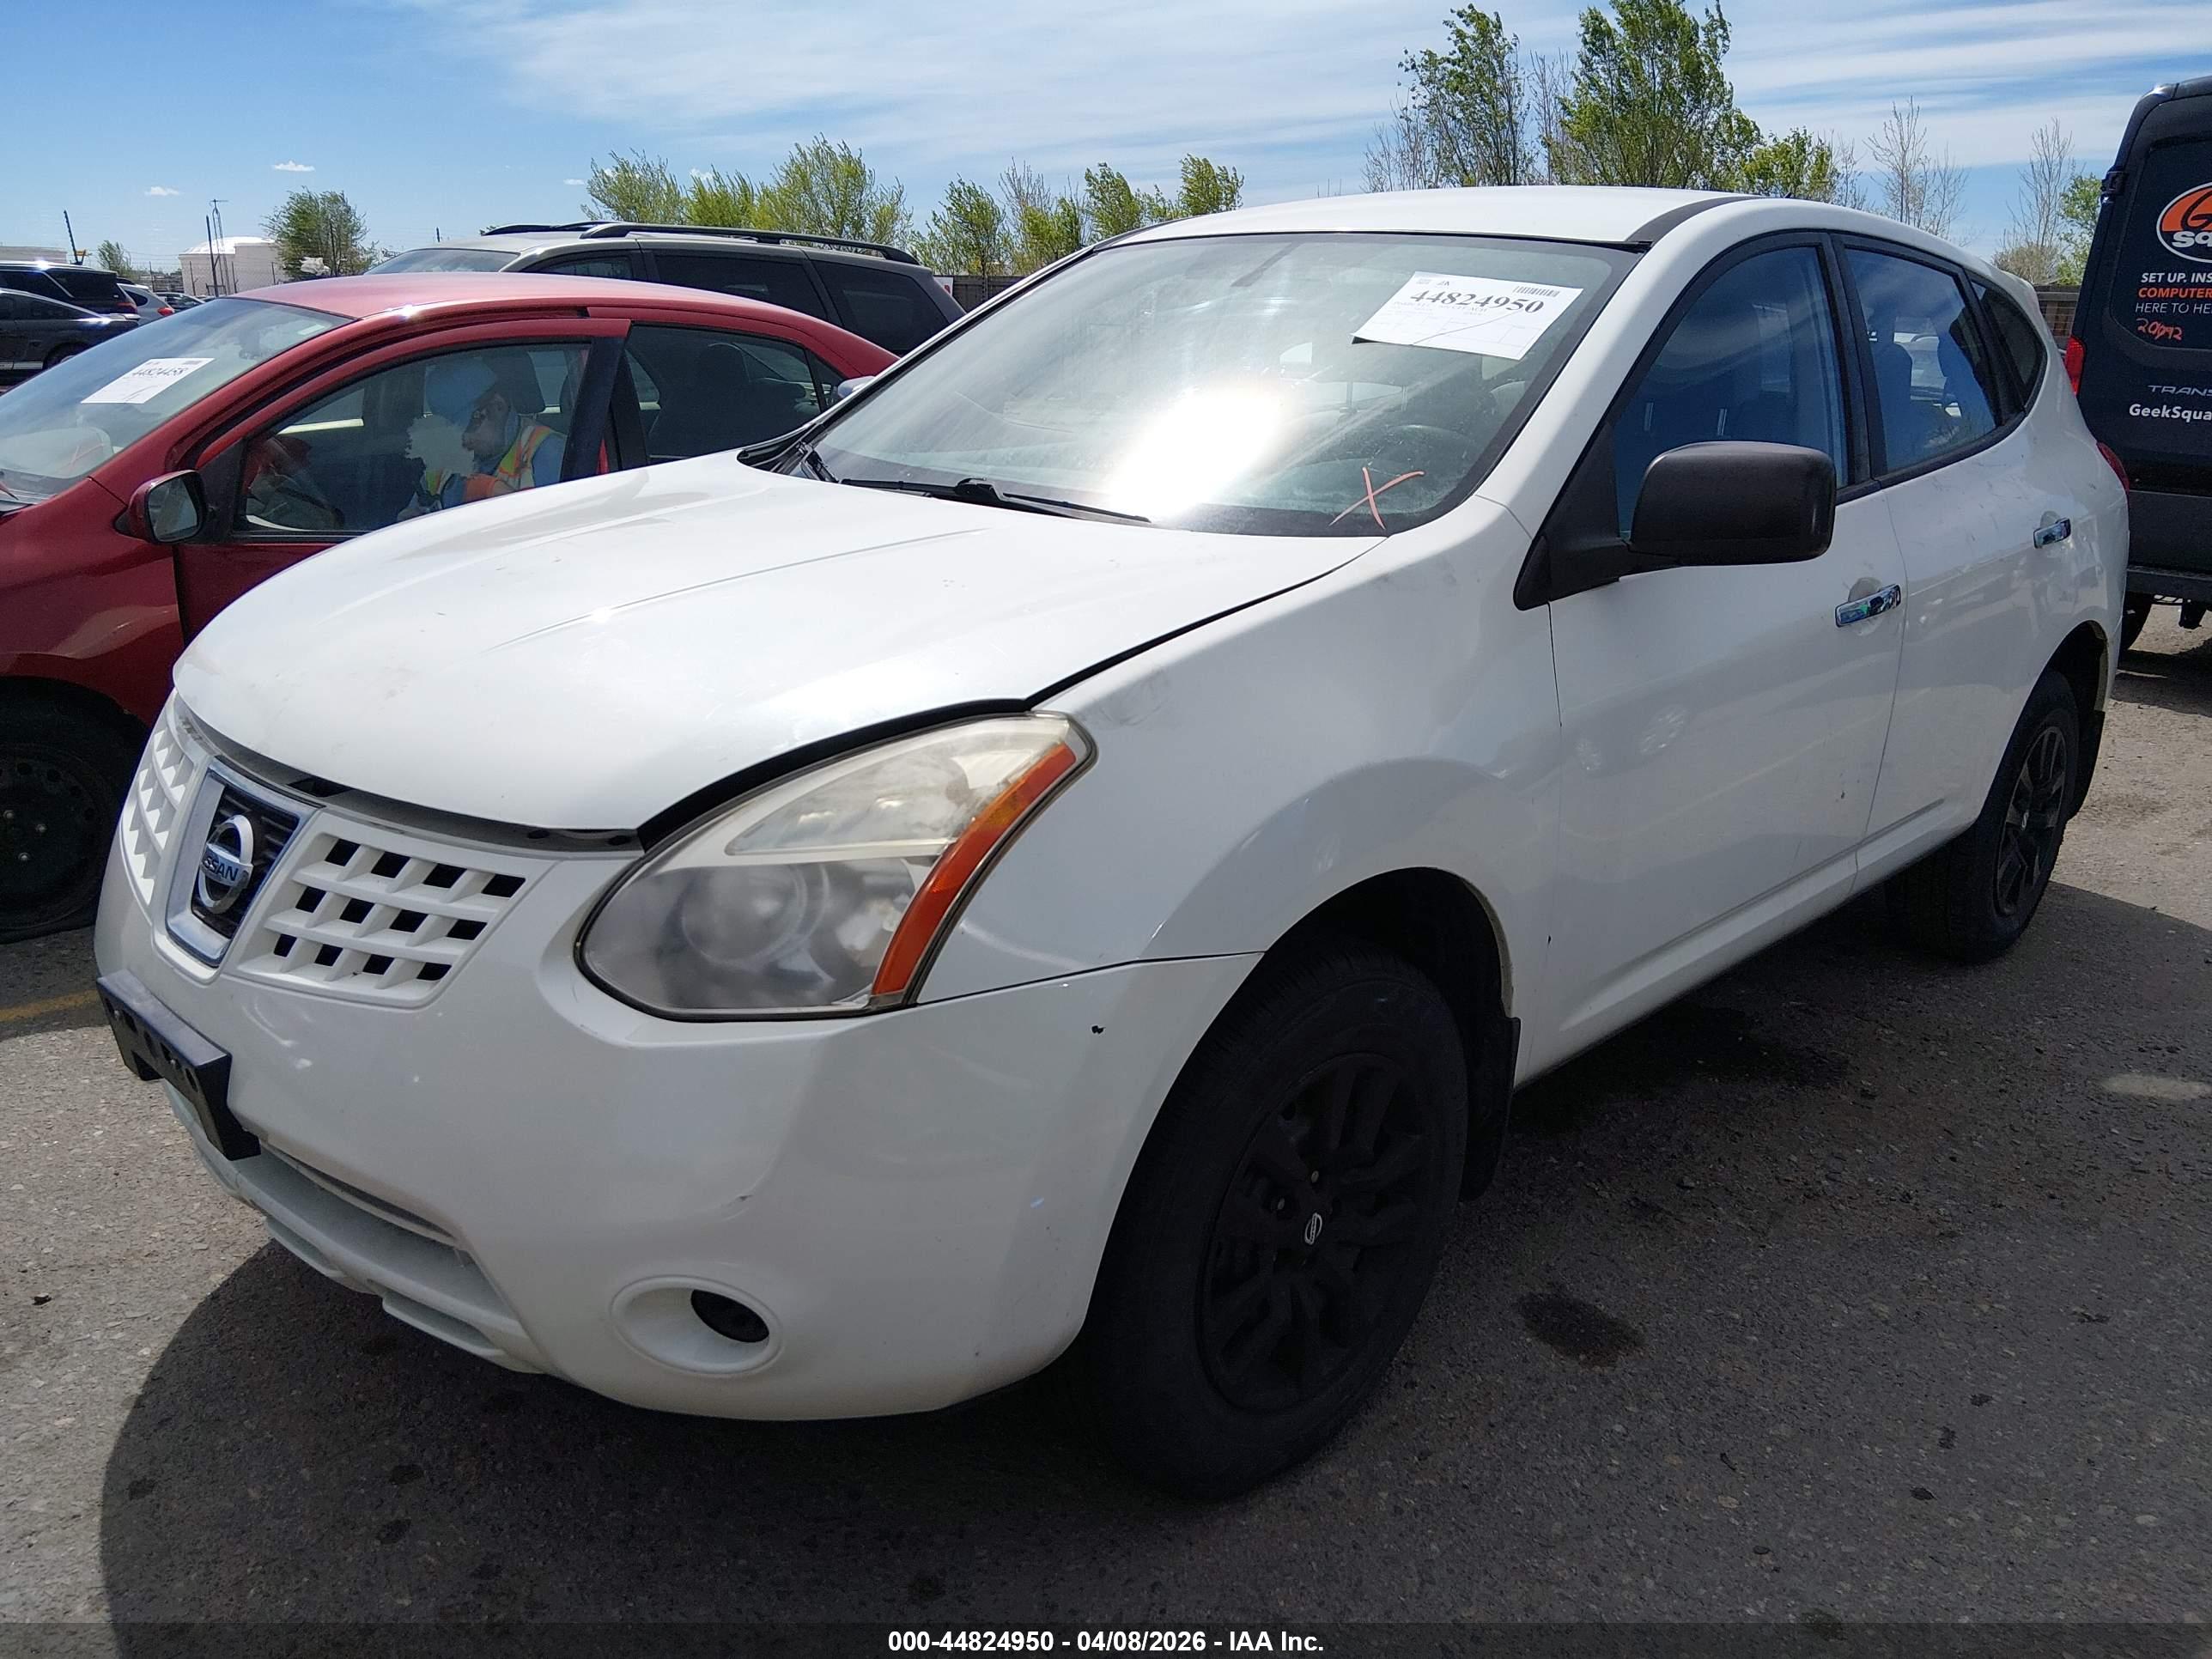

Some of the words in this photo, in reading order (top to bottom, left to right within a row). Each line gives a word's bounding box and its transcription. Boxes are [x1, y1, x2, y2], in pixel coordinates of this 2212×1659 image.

[2141, 272, 2166, 283] SET
[2166, 272, 2187, 283] UP.
[2191, 272, 2212, 283] INS
[2138, 287, 2212, 299] COMPUTER
[1409, 289, 1546, 314] 44824950
[2135, 302, 2169, 313] HERE
[2171, 302, 2191, 314] TO
[2192, 303, 2212, 314] HE
[2129, 403, 2212, 423] GeekSqua
